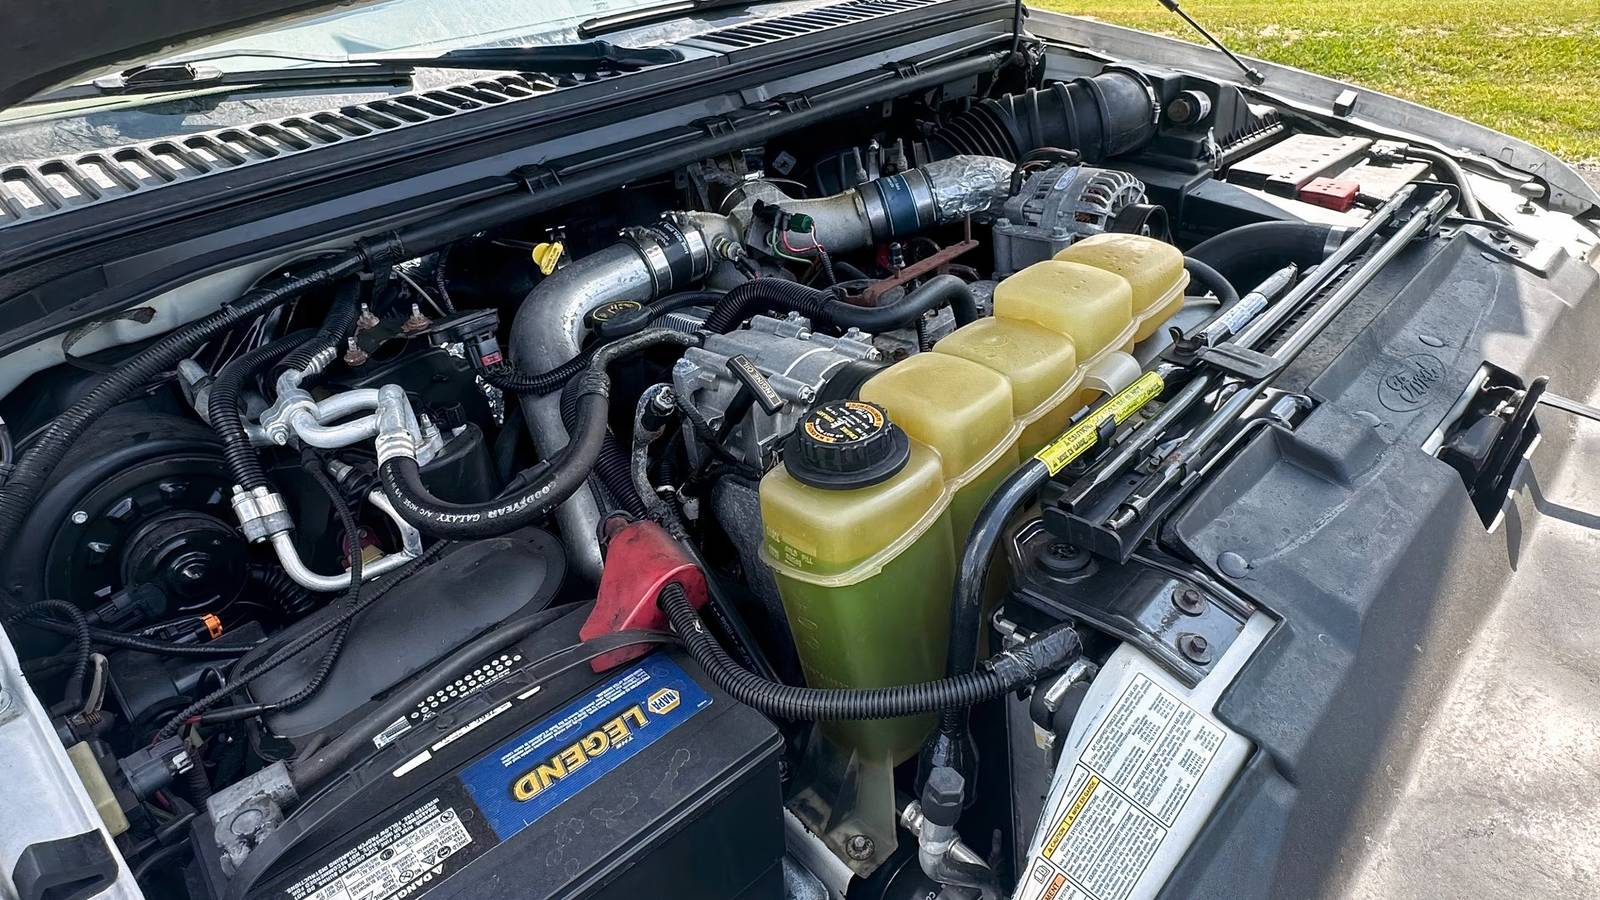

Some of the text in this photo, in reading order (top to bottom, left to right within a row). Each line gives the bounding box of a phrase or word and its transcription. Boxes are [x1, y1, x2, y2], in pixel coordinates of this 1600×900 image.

[742, 361, 776, 401] ENGINE OIL
[1386, 362, 1439, 403] Ford
[403, 498, 420, 511] HOSE
[488, 480, 556, 518] GOODYEAR
[436, 512, 480, 523] GALAXY
[653, 691, 676, 711] NAPA
[512, 704, 649, 802] LEGEND
[615, 736, 634, 750] THE
[1071, 802, 1081, 815] MISE
[1078, 795, 1086, 804] EN
[1083, 780, 1096, 797] GARDE
[378, 819, 402, 836] FOLLOW
[1049, 826, 1066, 848] CAUTION
[356, 833, 379, 850] PROPER
[327, 847, 357, 867] CHARGING
